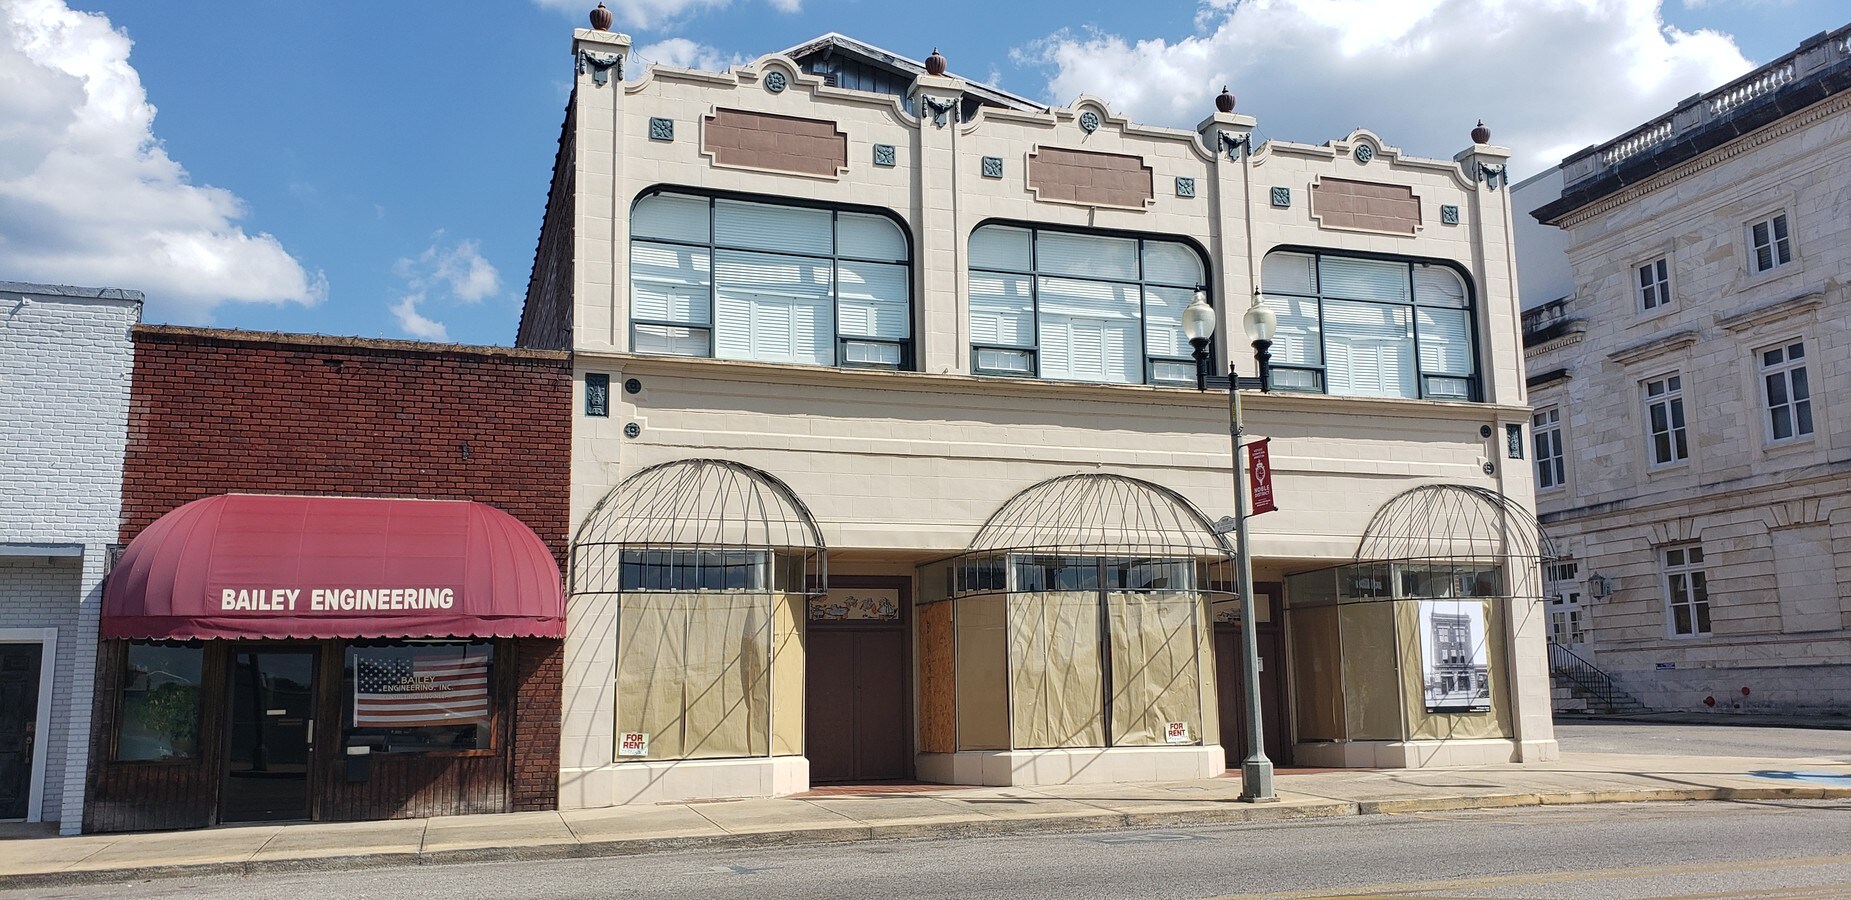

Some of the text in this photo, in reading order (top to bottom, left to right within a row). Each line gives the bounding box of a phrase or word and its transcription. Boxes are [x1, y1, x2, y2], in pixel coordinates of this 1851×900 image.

[221, 588, 454, 611] BAILEY ENGINEERING
[401, 676, 436, 684] BAILEY
[623, 741, 645, 749] RENT
